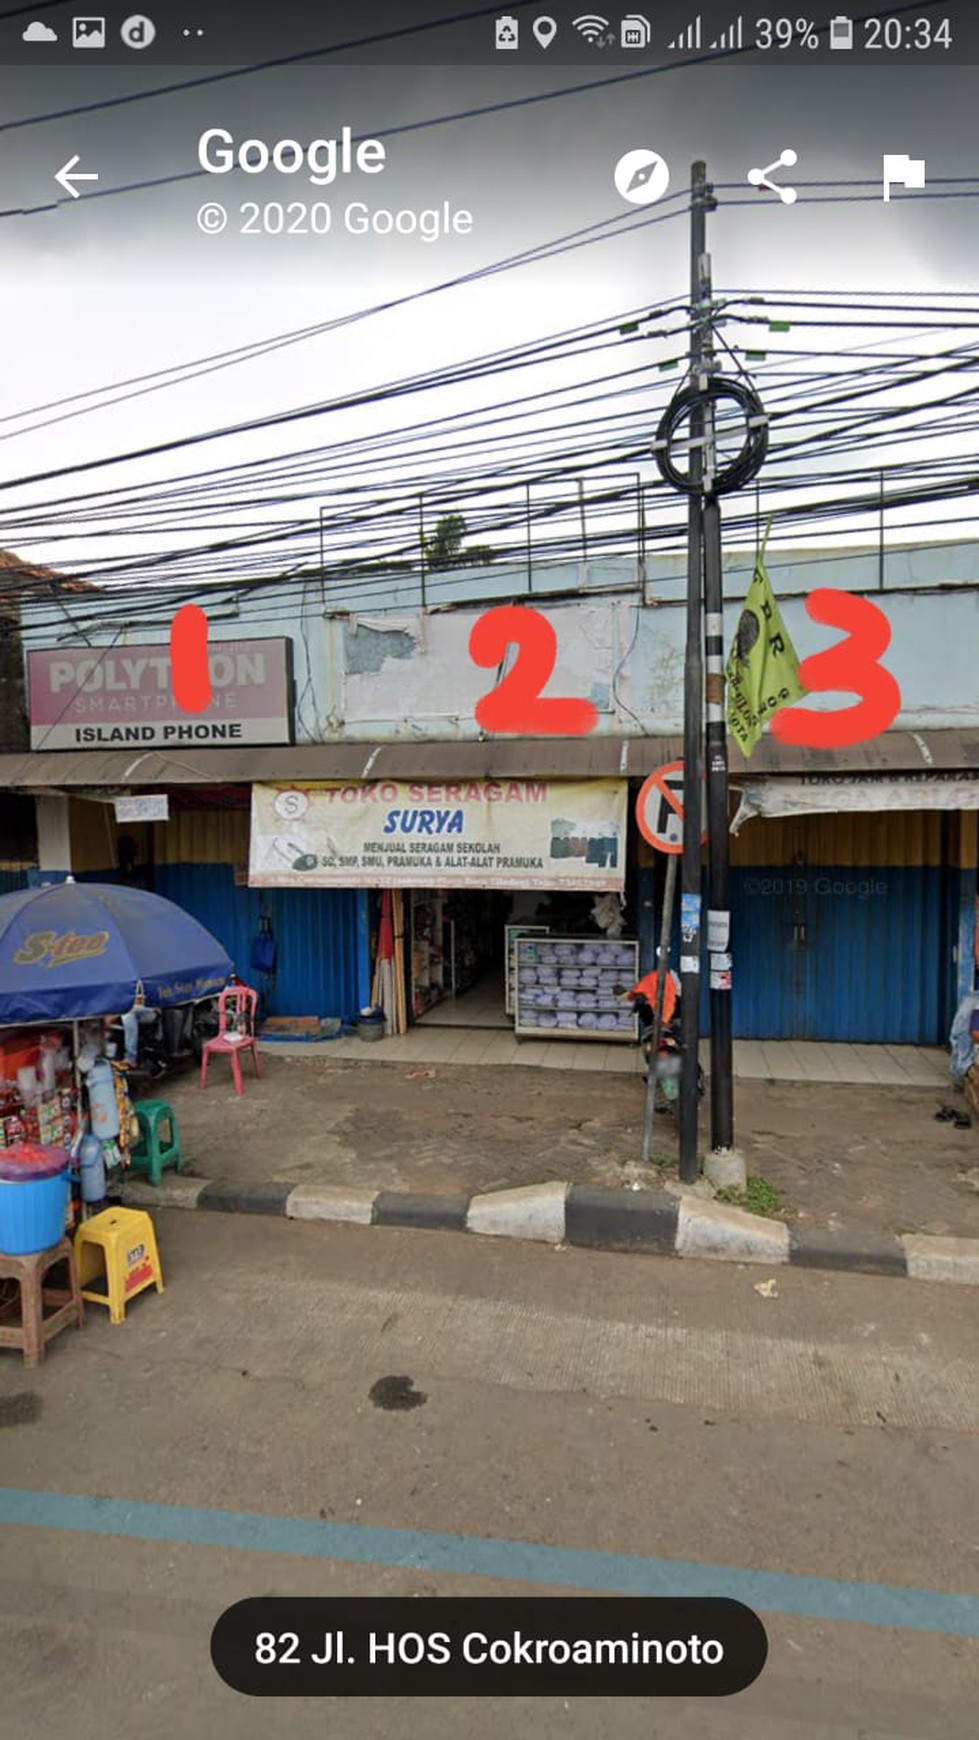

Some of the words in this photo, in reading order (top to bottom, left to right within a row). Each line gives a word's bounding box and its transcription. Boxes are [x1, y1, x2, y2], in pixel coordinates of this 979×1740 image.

[50, 653, 265, 693] POLYTON
[76, 692, 237, 713] SMARTPNE
[75, 726, 155, 743] ISLAND
[163, 723, 242, 740] PHONE
[325, 783, 398, 804] TOKO
[408, 780, 548, 804] SERAGAM
[383, 809, 464, 835] SURYA
[363, 842, 407, 853] MENJUAL
[409, 842, 454, 853] SERAGAM
[456, 843, 501, 854] SEKOLAH
[387, 857, 432, 868] PRAMUKA
[434, 857, 442, 868] &
[444, 857, 494, 868] ALAT-ALAT
[496, 858, 544, 869] PRAMUKA
